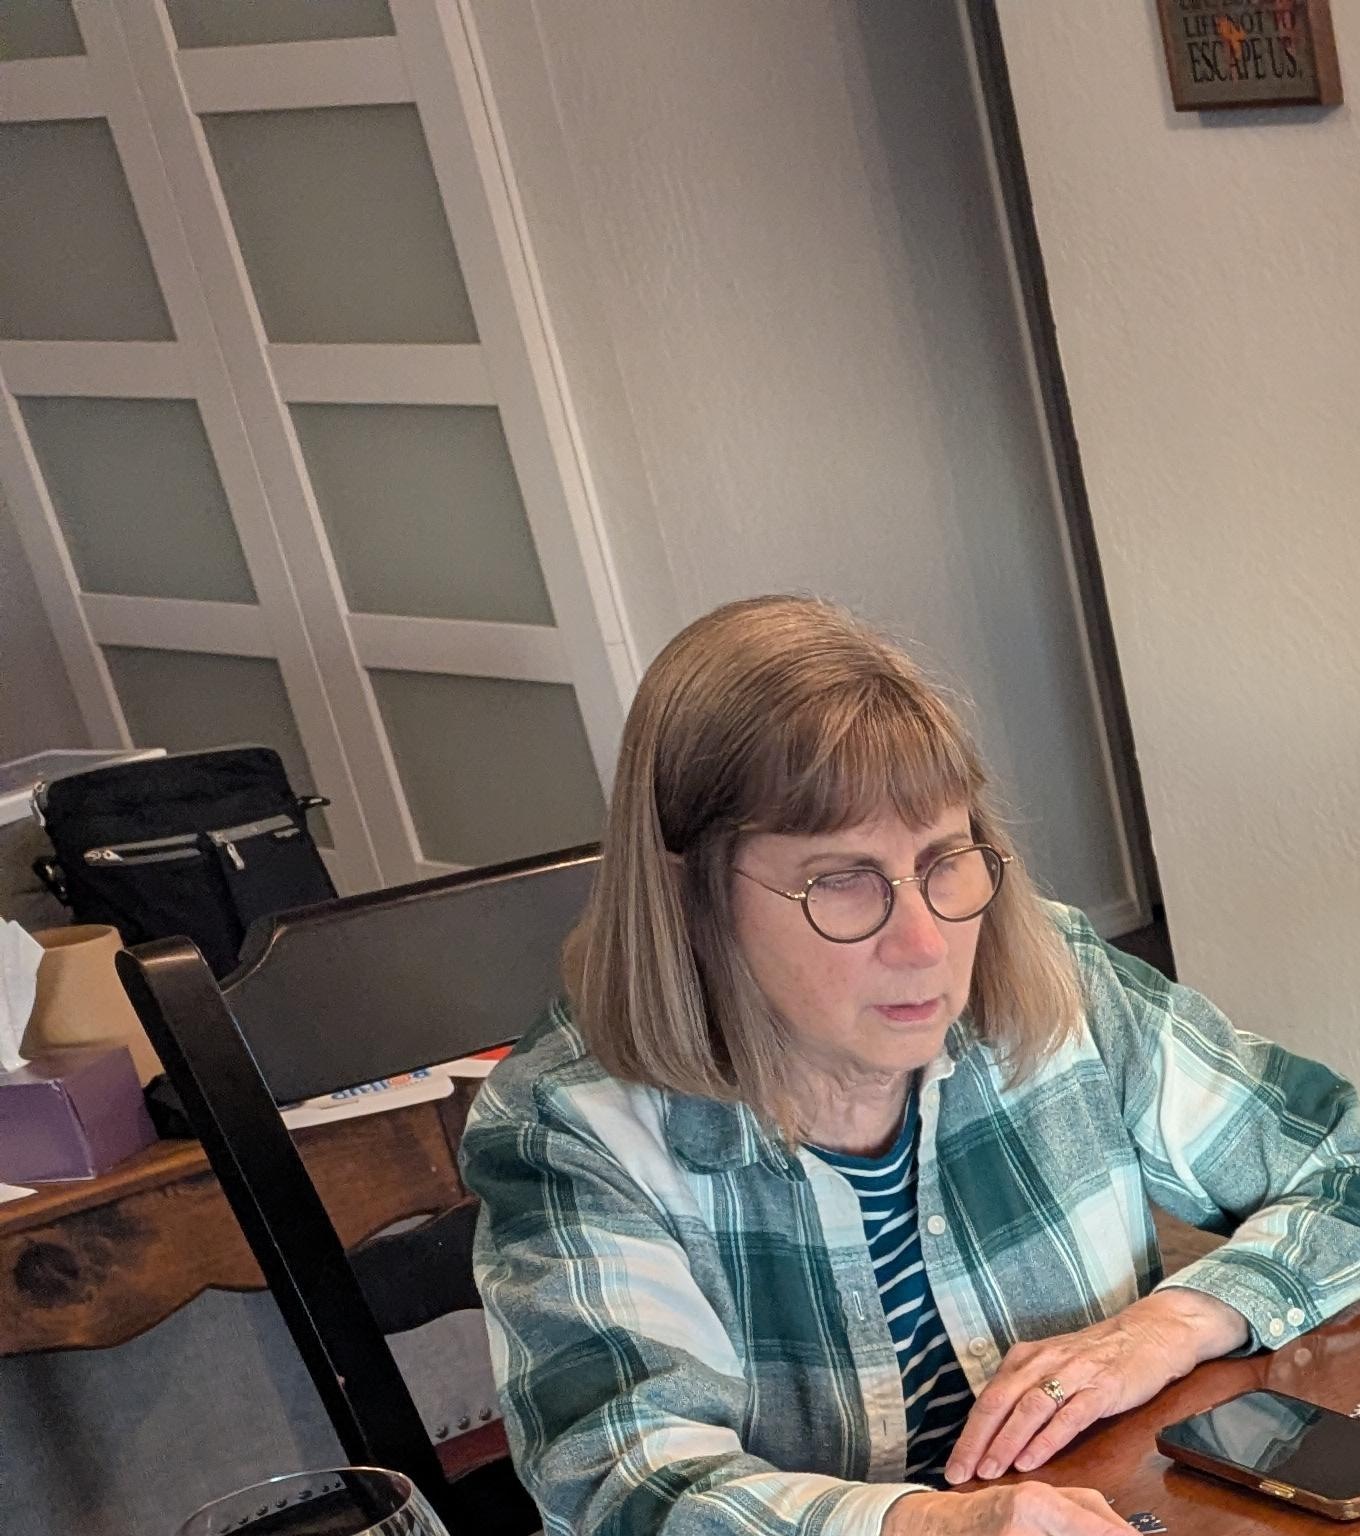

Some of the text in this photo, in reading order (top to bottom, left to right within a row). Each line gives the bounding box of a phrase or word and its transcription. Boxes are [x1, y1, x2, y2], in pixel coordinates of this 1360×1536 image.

[1182, 9, 1297, 38] LIFE NOT TO
[1186, 37, 1266, 83] ESCAPE
